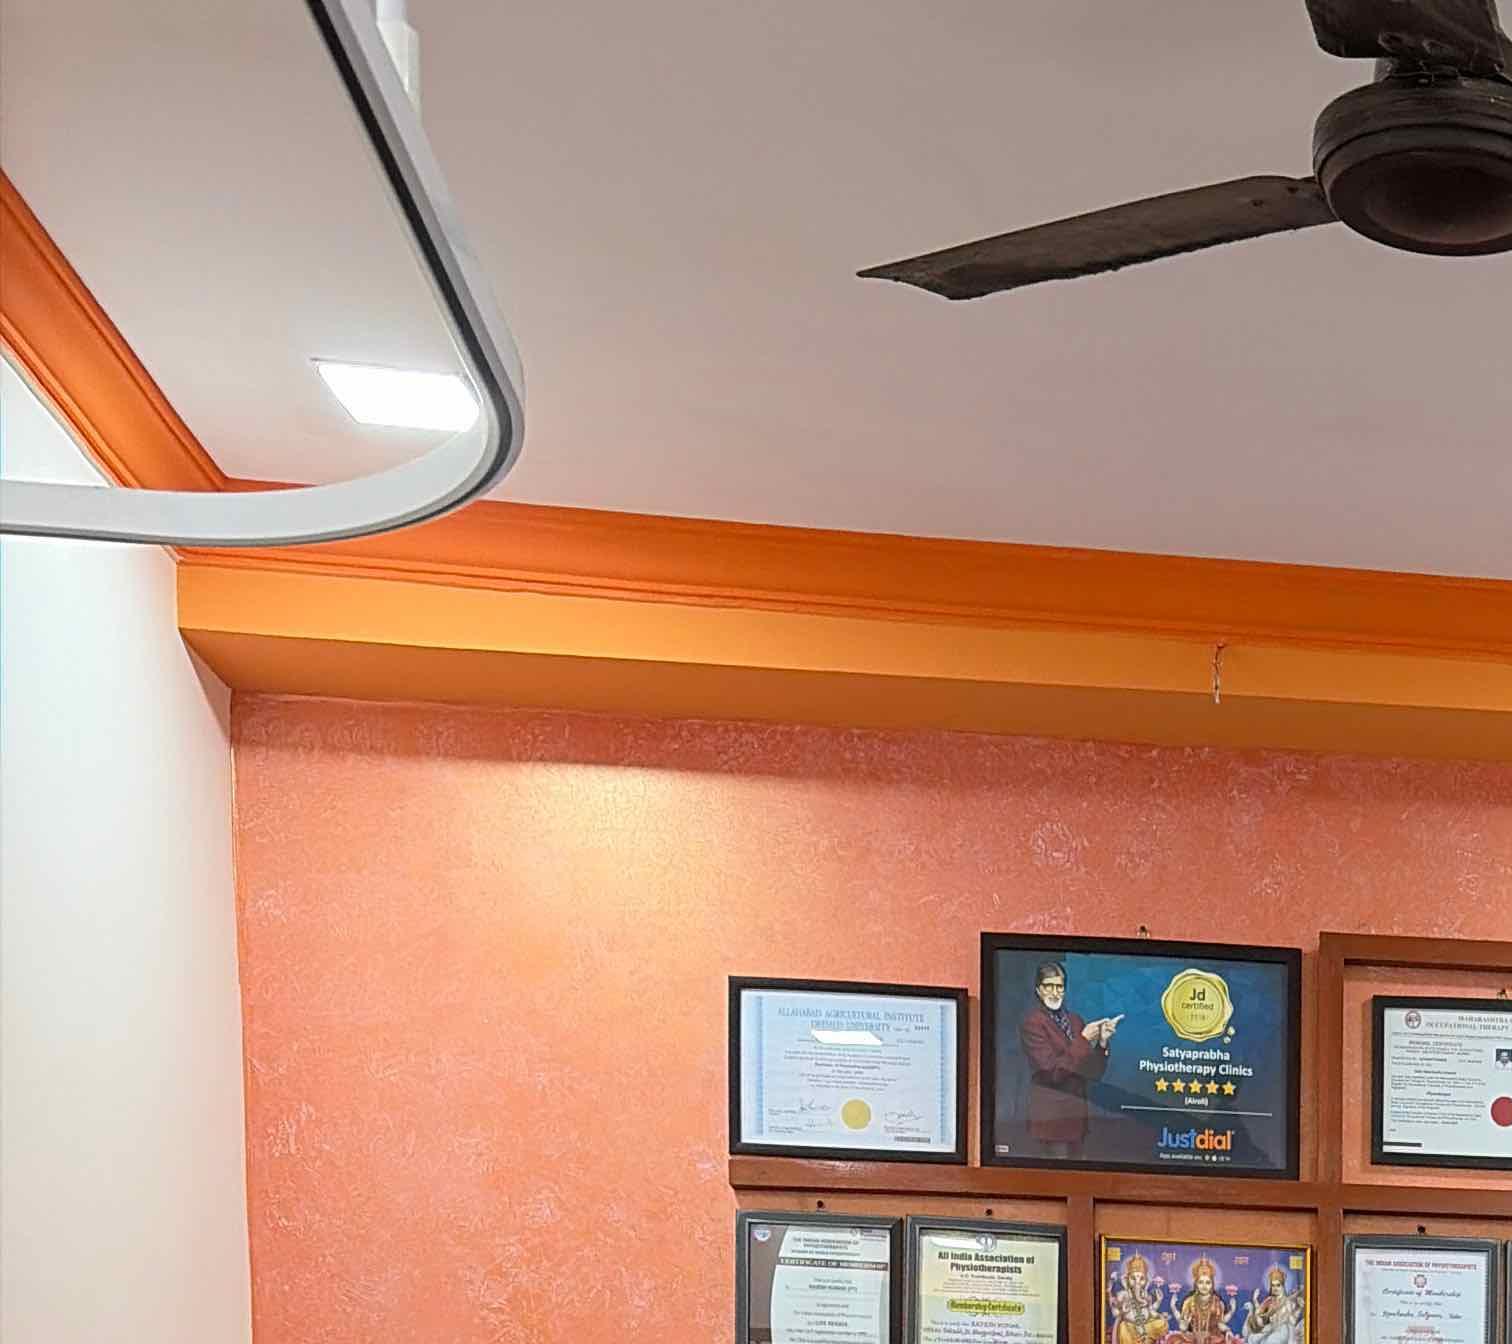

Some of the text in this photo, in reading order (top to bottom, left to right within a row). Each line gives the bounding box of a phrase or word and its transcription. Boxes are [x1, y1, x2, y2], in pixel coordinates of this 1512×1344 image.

[1189, 988, 1206, 1001] Jd
[1181, 1001, 1214, 1010] certified
[1162, 1046, 1230, 1061] Satyaprabha
[1139, 1059, 1253, 1076] Physiotherapy Clinics
[1157, 1127, 1232, 1151] Justdial
[951, 1252, 972, 1261] India
[974, 1252, 1024, 1263] Association
[950, 1262, 1022, 1274] Physiotherapists
